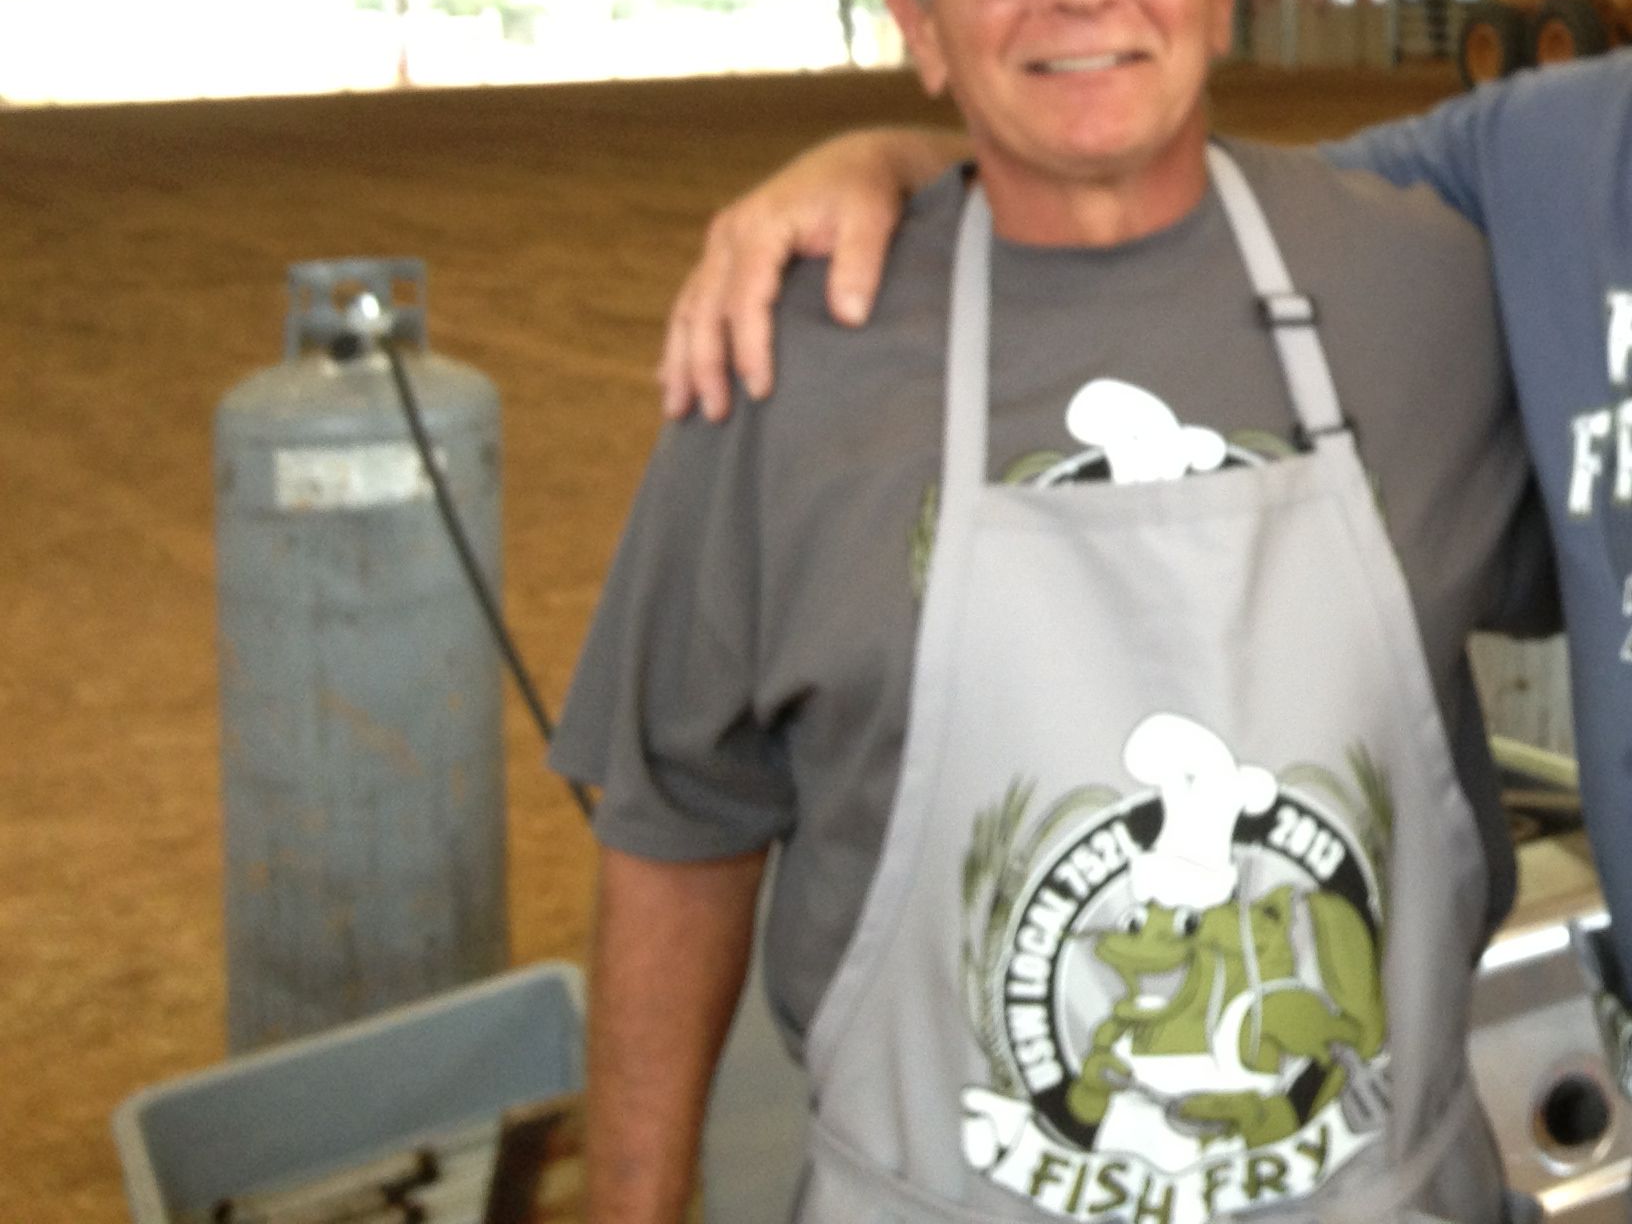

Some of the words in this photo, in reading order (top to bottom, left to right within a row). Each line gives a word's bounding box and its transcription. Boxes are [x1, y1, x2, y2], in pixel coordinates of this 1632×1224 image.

[1007, 886, 1079, 998] LOCAL
[1008, 1004, 1063, 1094] USW
[1029, 1150, 1176, 1223] FISH
[1202, 1125, 1330, 1214] FRY
